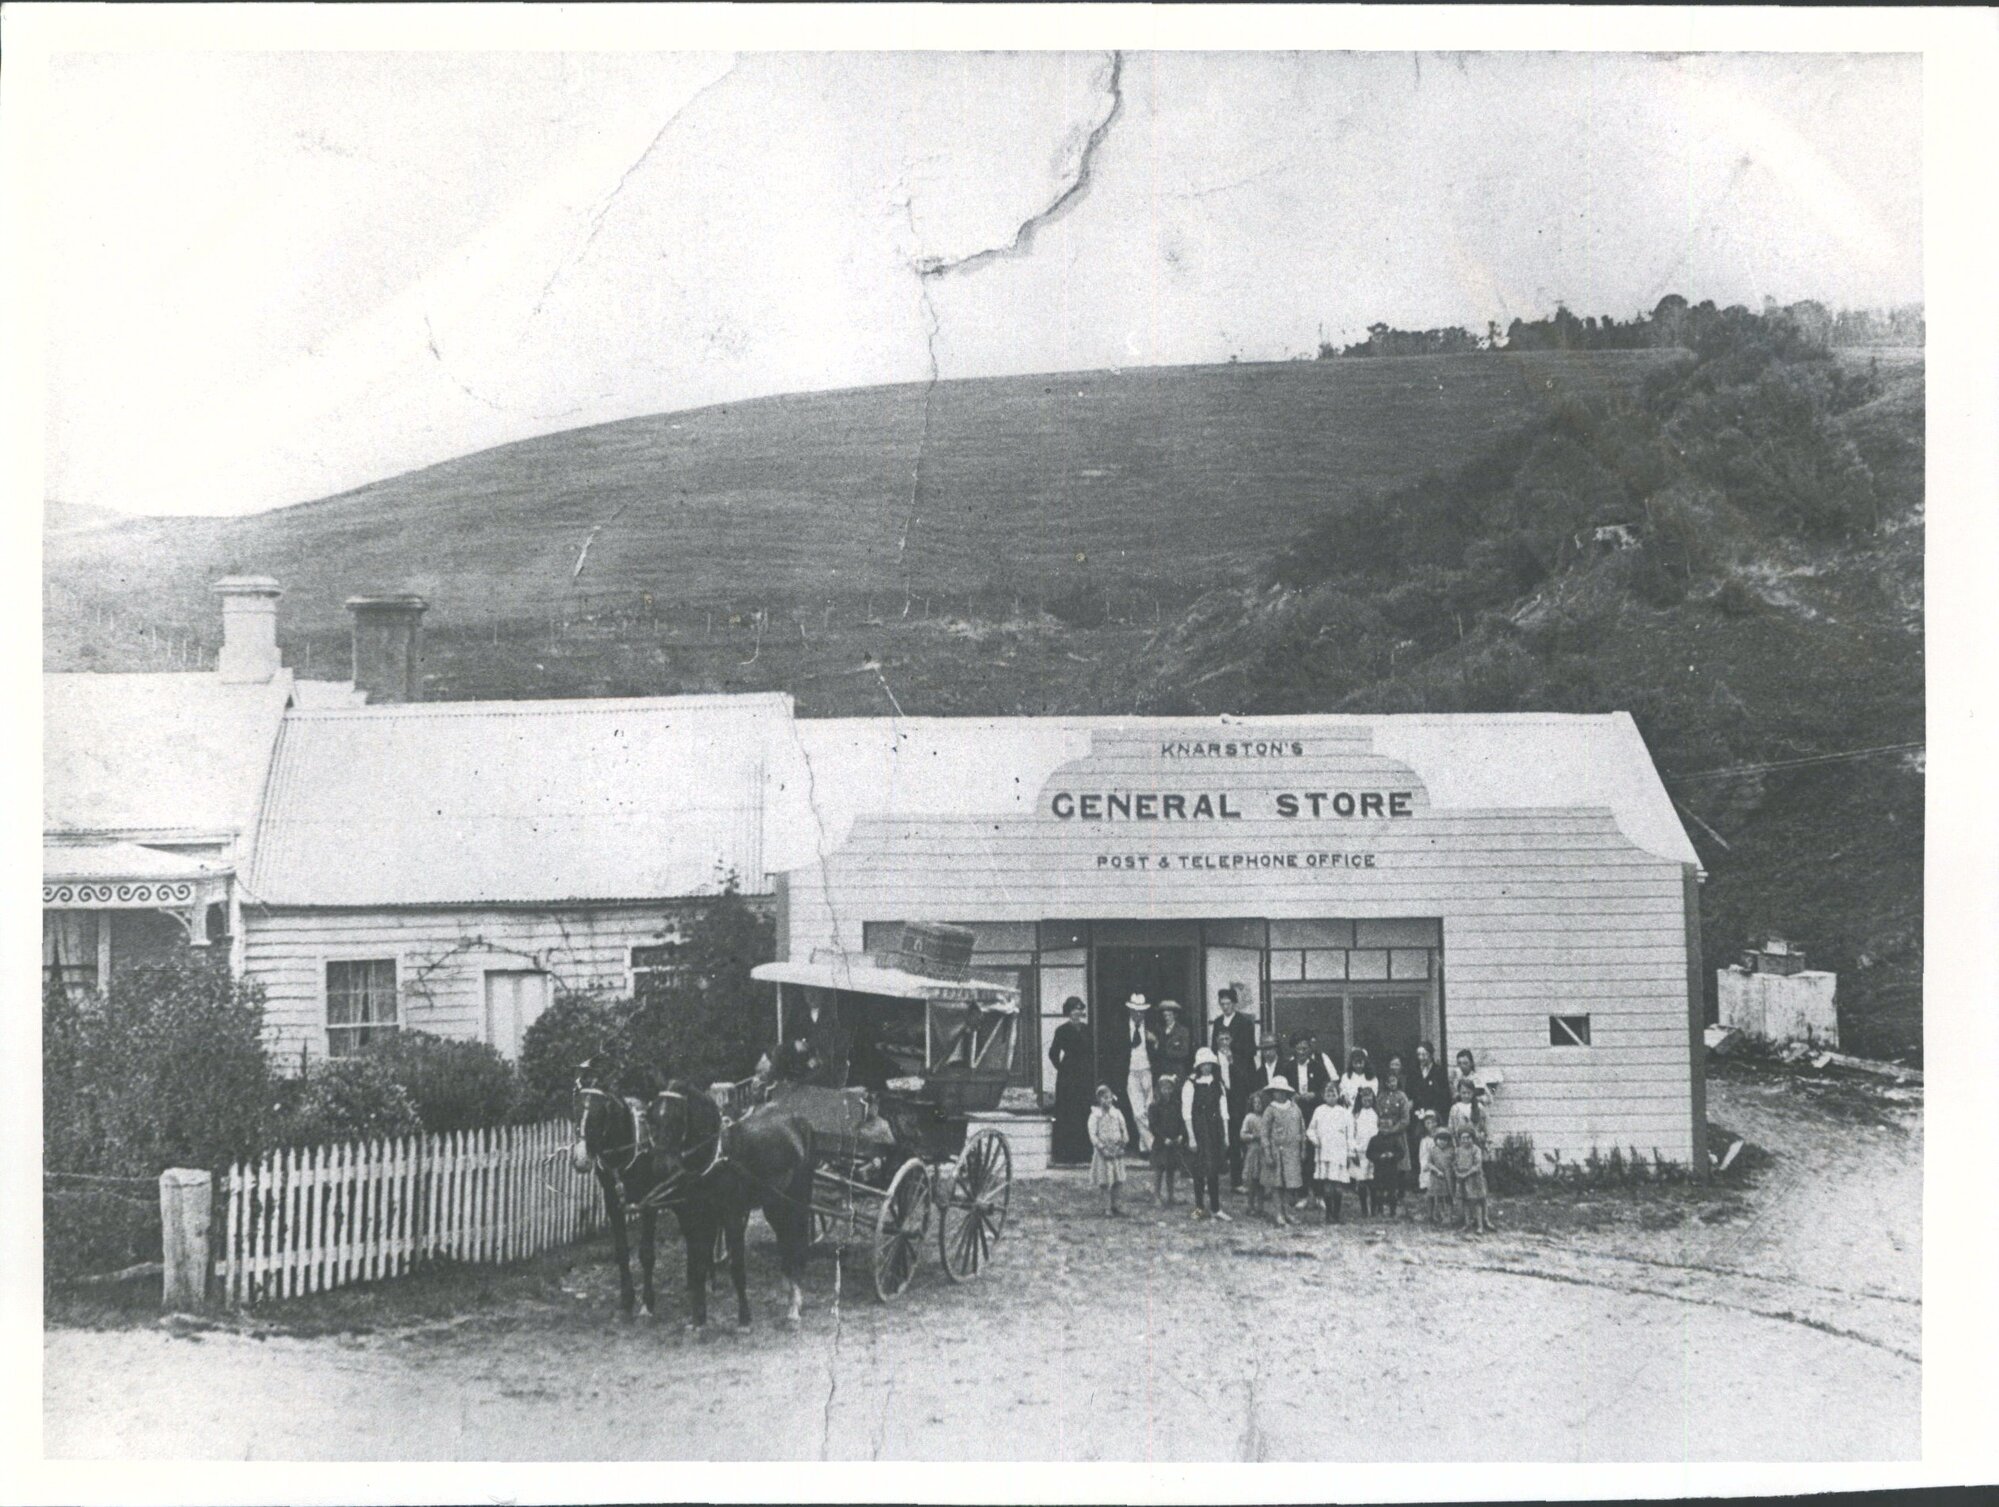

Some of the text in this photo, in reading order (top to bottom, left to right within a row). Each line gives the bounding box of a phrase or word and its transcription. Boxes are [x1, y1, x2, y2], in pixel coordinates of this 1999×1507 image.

[1161, 741, 1304, 757] KNARSTON'S
[1051, 791, 1414, 819] GENERAL STORE
[1096, 854, 1376, 869] POST & TELEPHONE OFFICE
